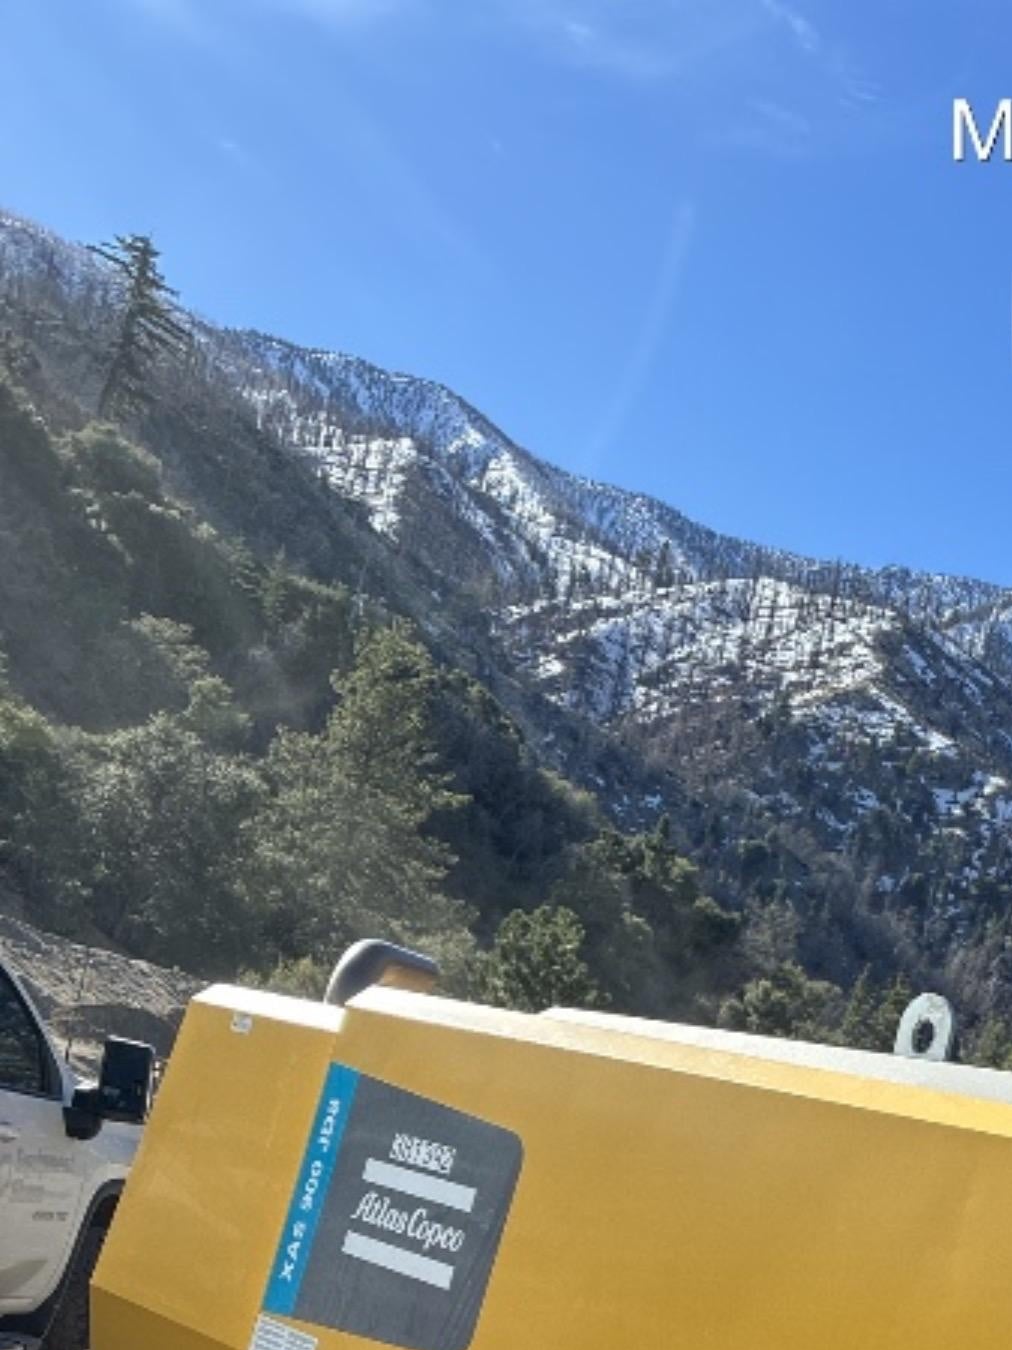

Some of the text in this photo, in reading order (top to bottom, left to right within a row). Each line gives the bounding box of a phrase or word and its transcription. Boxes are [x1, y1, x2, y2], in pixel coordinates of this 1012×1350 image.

[279, 1220, 307, 1281] XAS
[300, 1159, 324, 1212] 900
[349, 1190, 465, 1252] Atlas Copco
